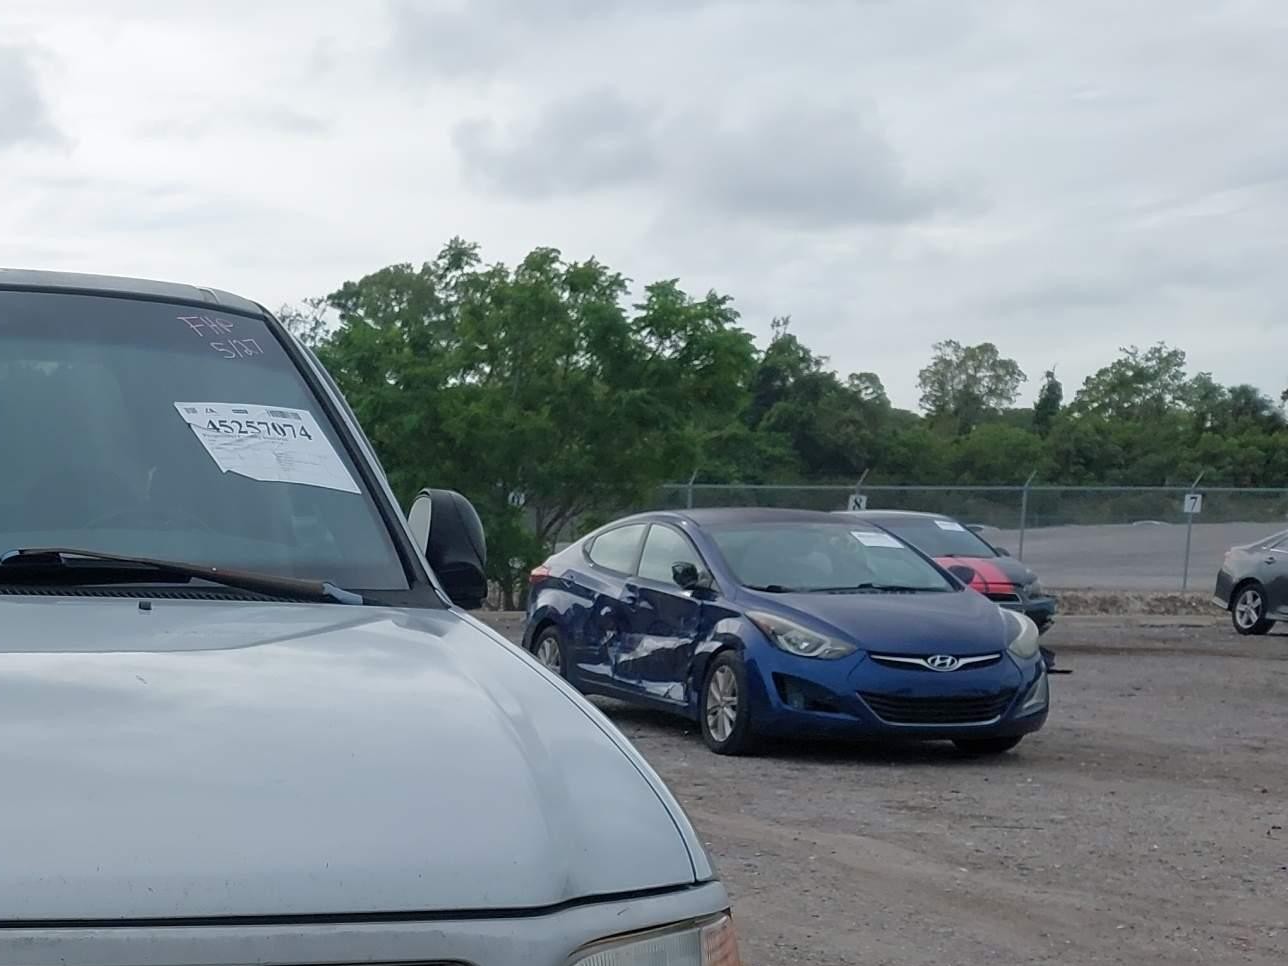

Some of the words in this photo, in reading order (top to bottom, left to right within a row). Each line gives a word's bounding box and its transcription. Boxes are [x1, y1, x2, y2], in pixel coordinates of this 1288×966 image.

[206, 418, 313, 441] 45257074
[852, 497, 863, 511] 8
[1189, 495, 1199, 511] 7
